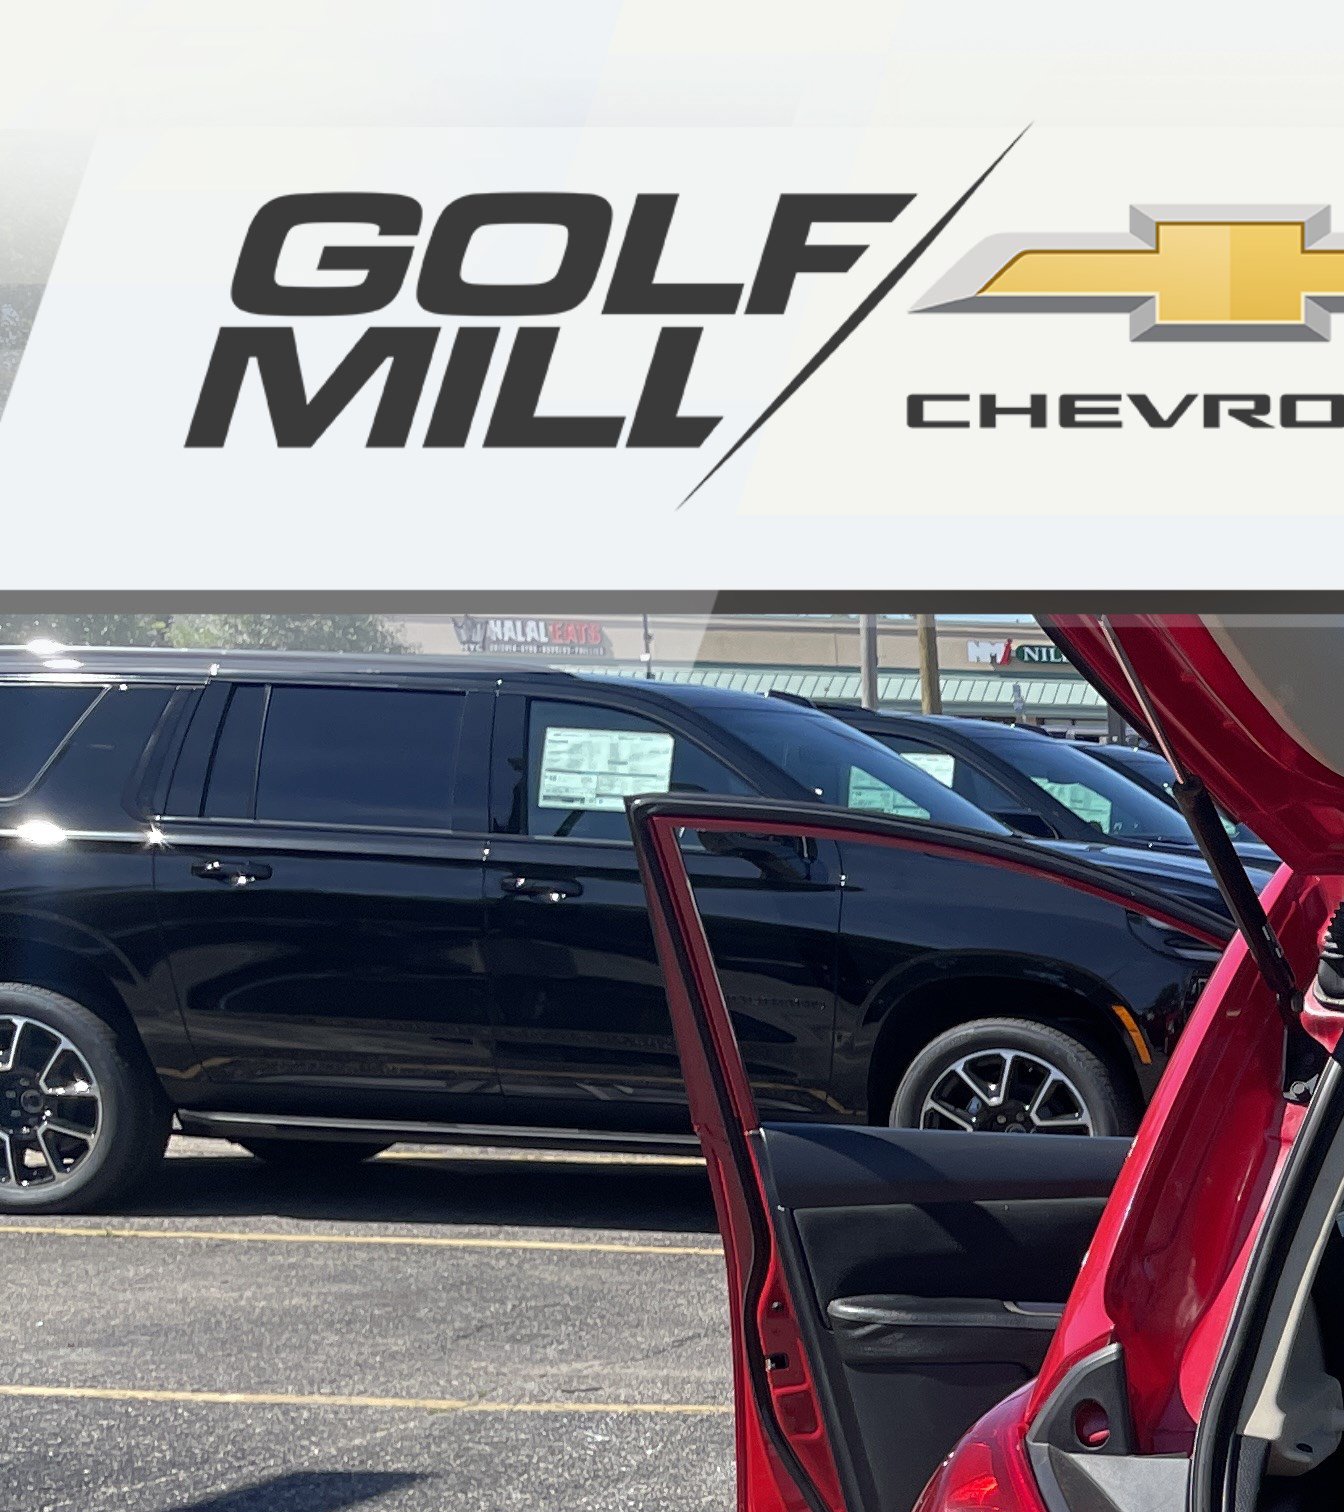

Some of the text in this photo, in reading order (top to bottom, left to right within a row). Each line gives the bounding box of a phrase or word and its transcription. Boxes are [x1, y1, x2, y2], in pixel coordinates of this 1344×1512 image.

[486, 619, 602, 644] HALAL EATS
[1022, 646, 1069, 663] NIL
